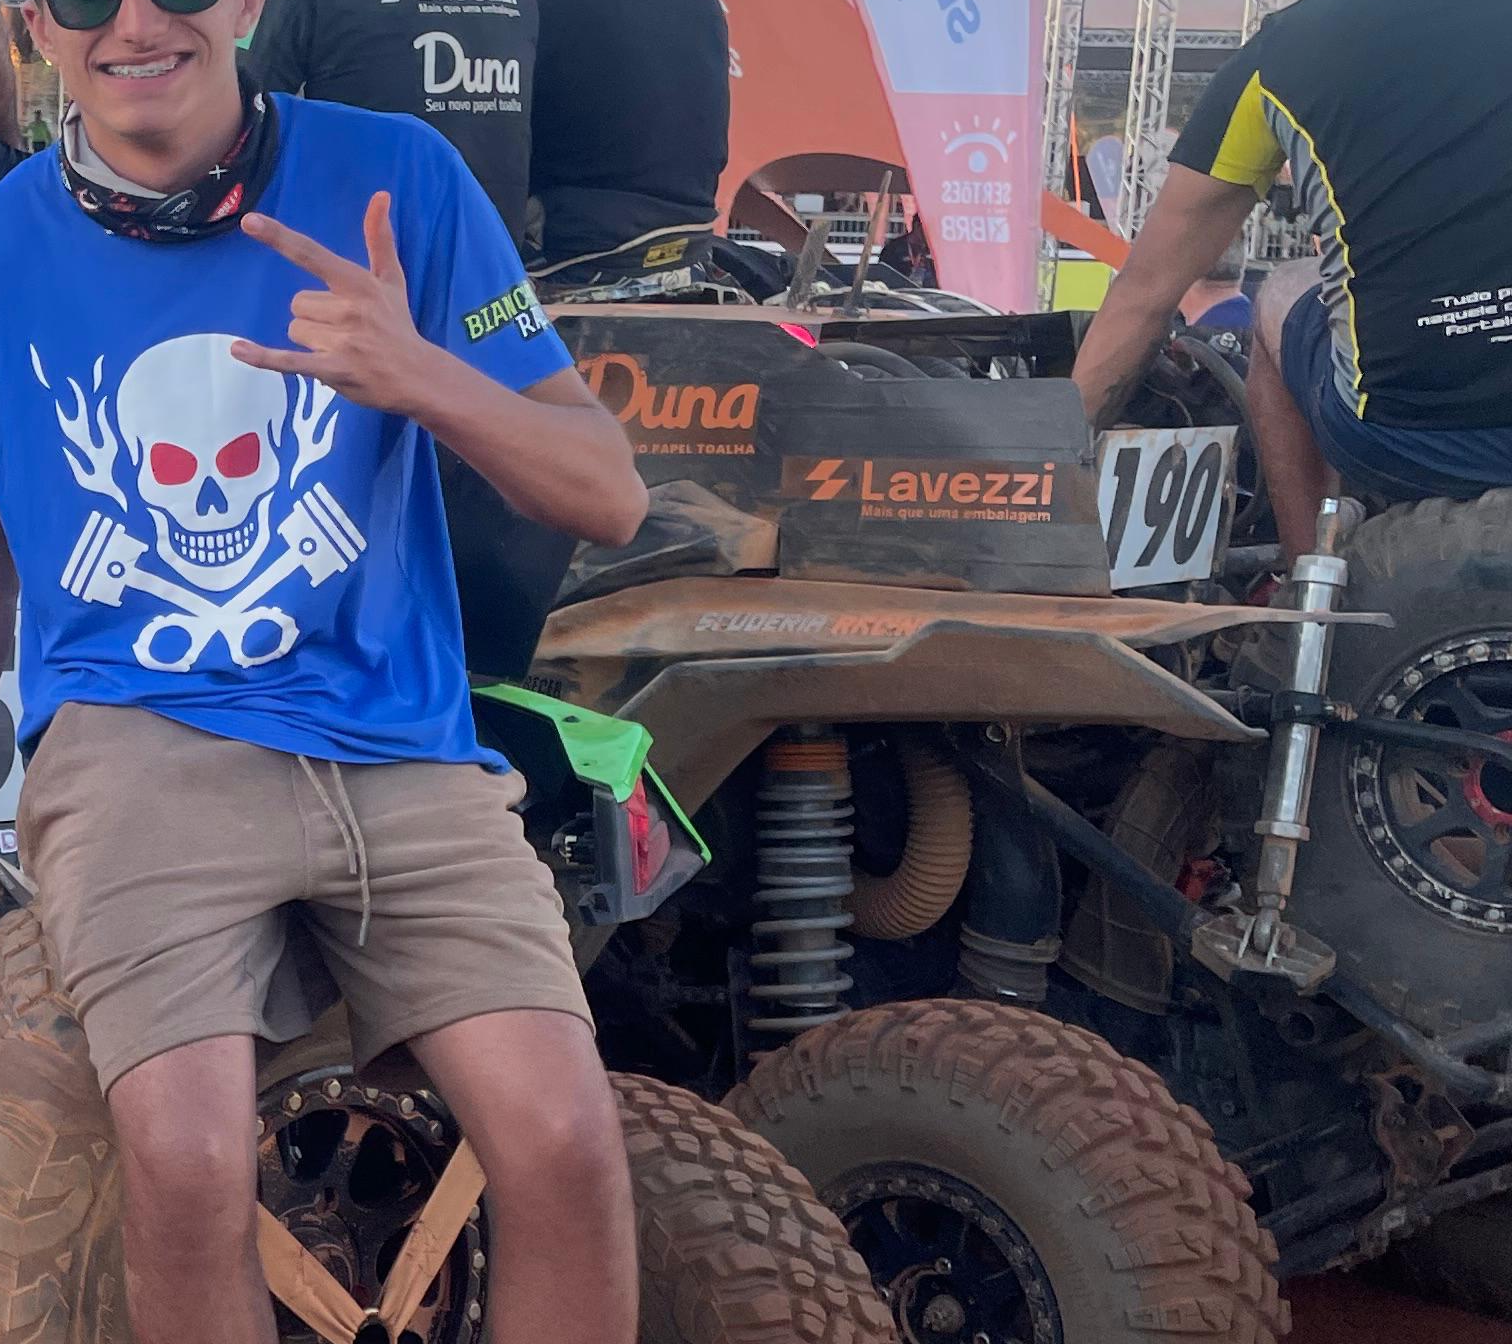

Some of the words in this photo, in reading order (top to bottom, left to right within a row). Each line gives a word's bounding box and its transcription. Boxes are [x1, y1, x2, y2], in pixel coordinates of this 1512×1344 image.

[413, 31, 520, 94] Duna
[425, 98, 446, 113] Seu
[472, 97, 498, 115] papel
[1430, 291, 1492, 308] Tudo
[651, 443, 692, 455] PAPEL
[696, 443, 757, 455] TOALHA
[861, 460, 1055, 506] Lavezzi
[862, 505, 893, 520] Mais
[897, 508, 924, 521] que
[929, 508, 959, 520] uma
[964, 507, 1052, 524] embalagem
[1105, 440, 1224, 572] 190
